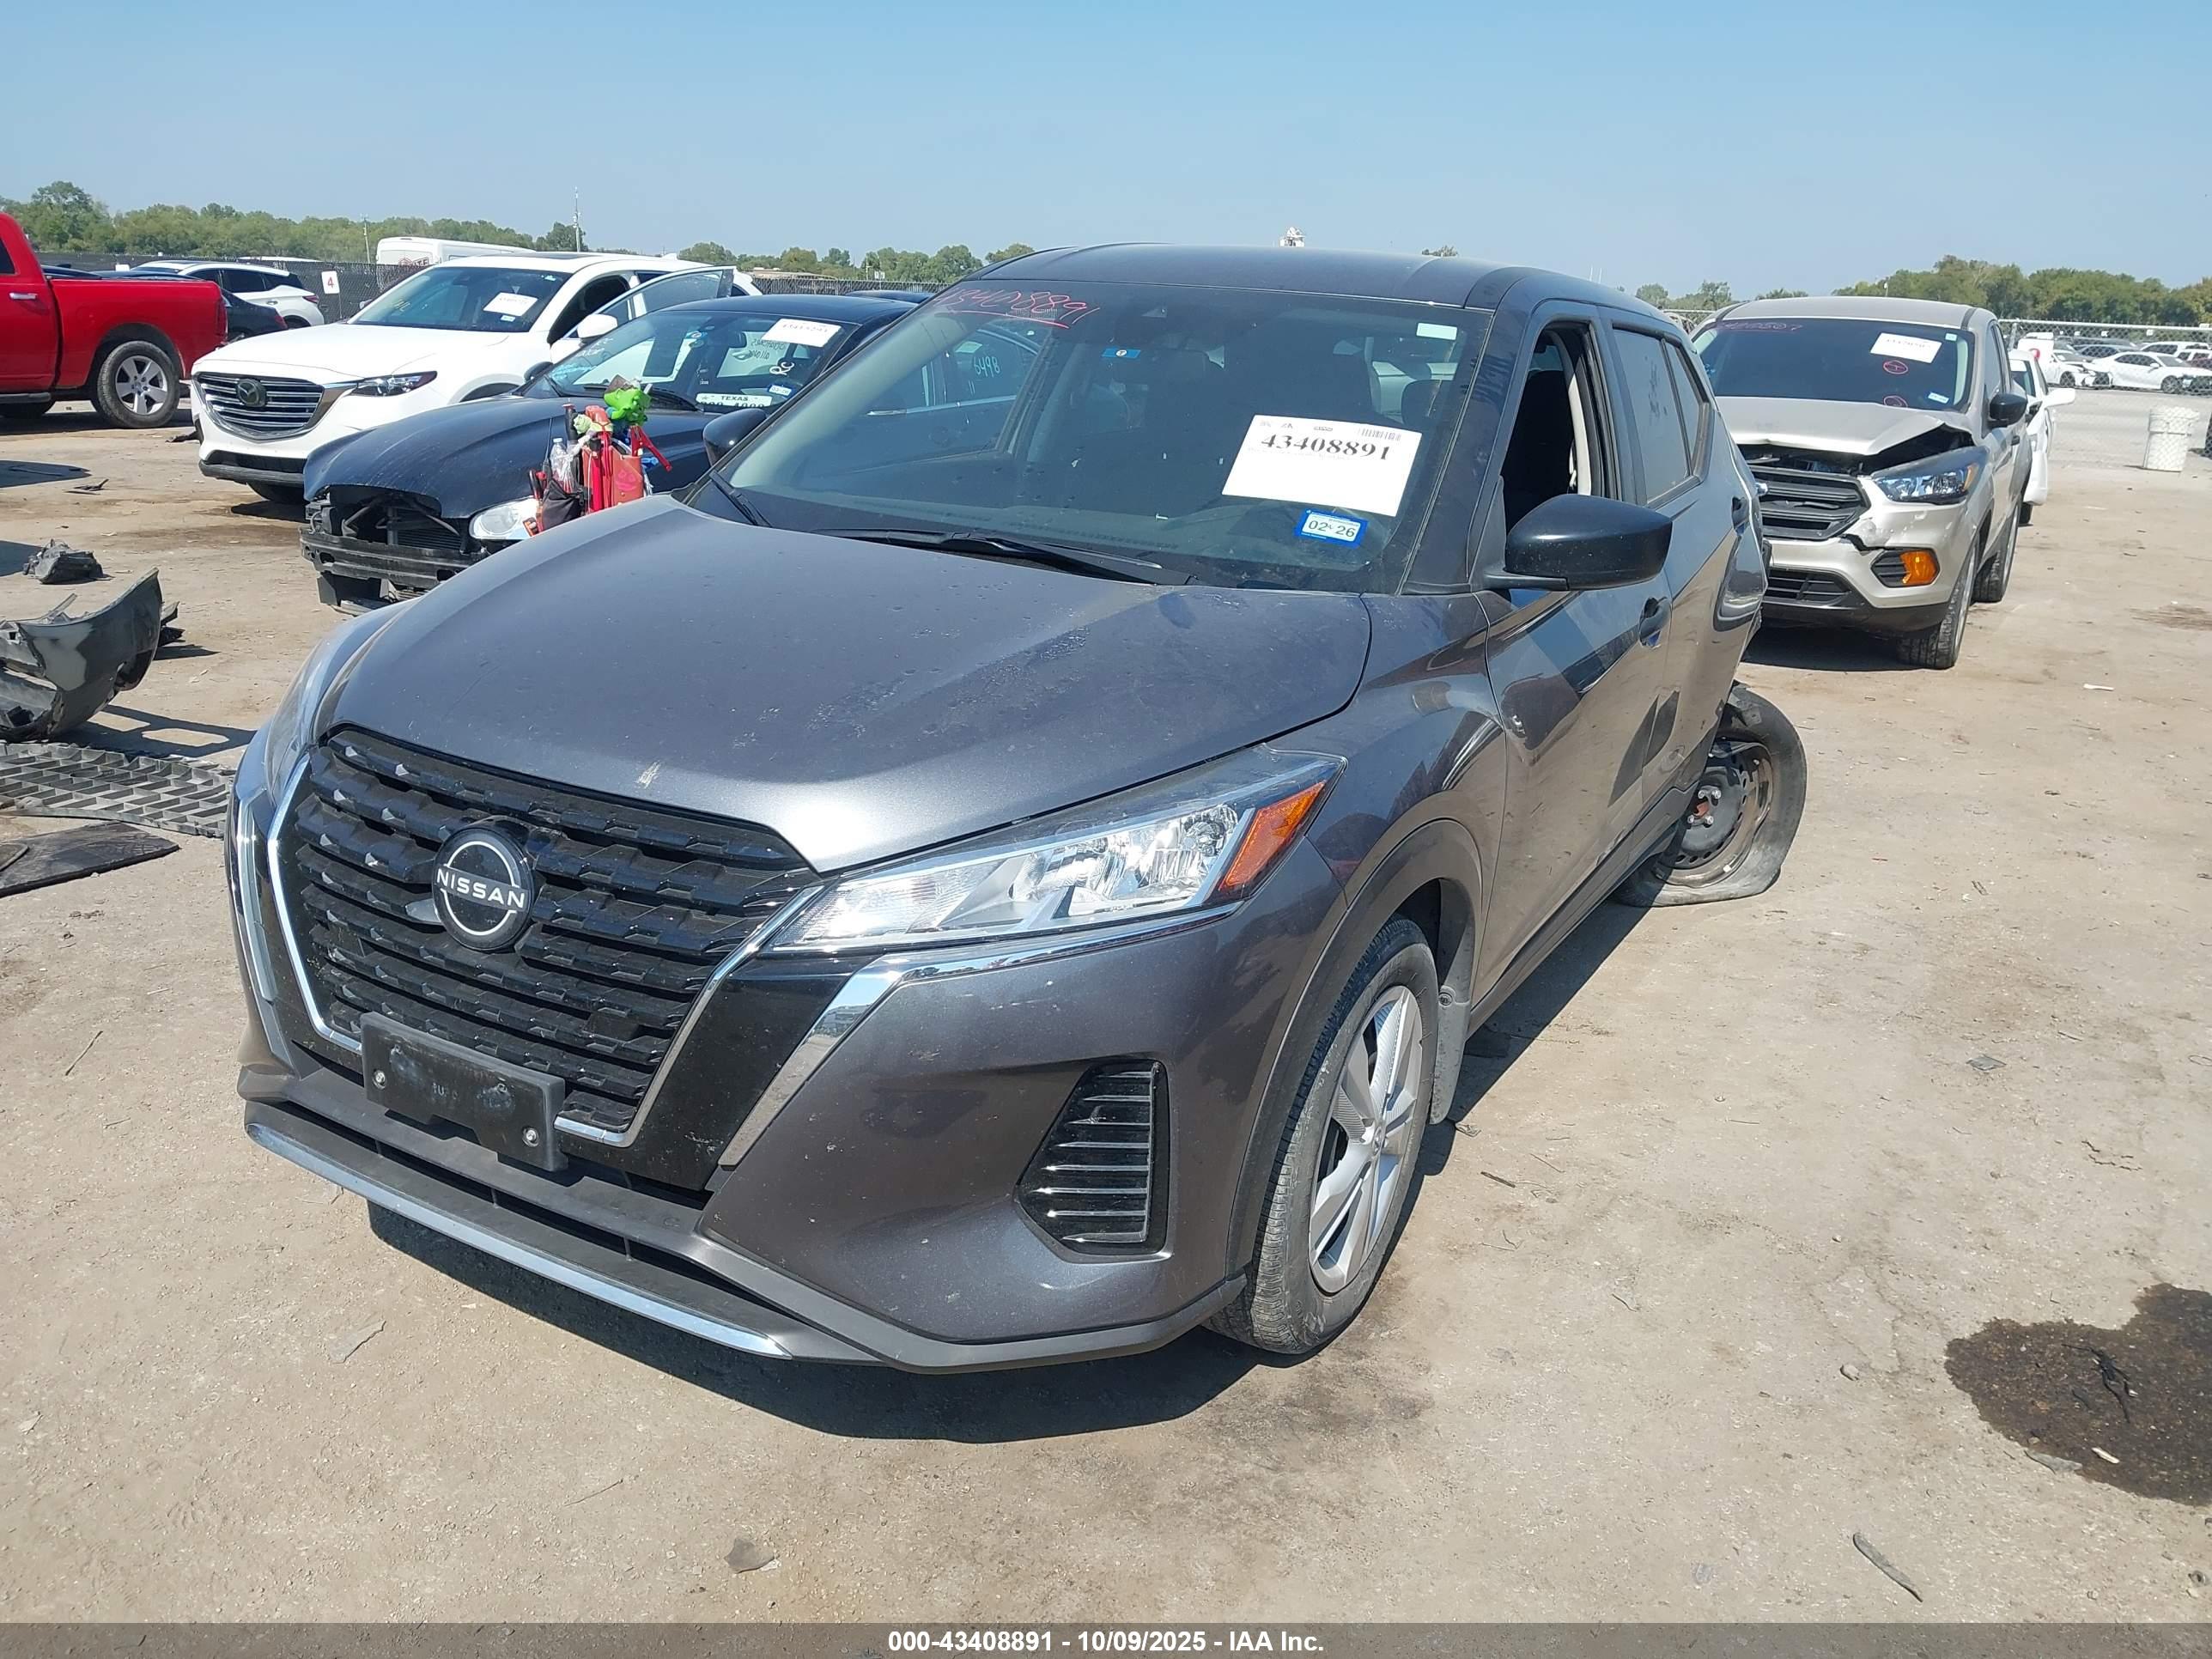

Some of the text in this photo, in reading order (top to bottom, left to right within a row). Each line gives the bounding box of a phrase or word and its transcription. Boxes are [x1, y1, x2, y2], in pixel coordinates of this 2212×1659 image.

[327, 276, 334, 289] 4
[1261, 434, 1390, 460] 43408891
[436, 868, 526, 908] NISSAN
